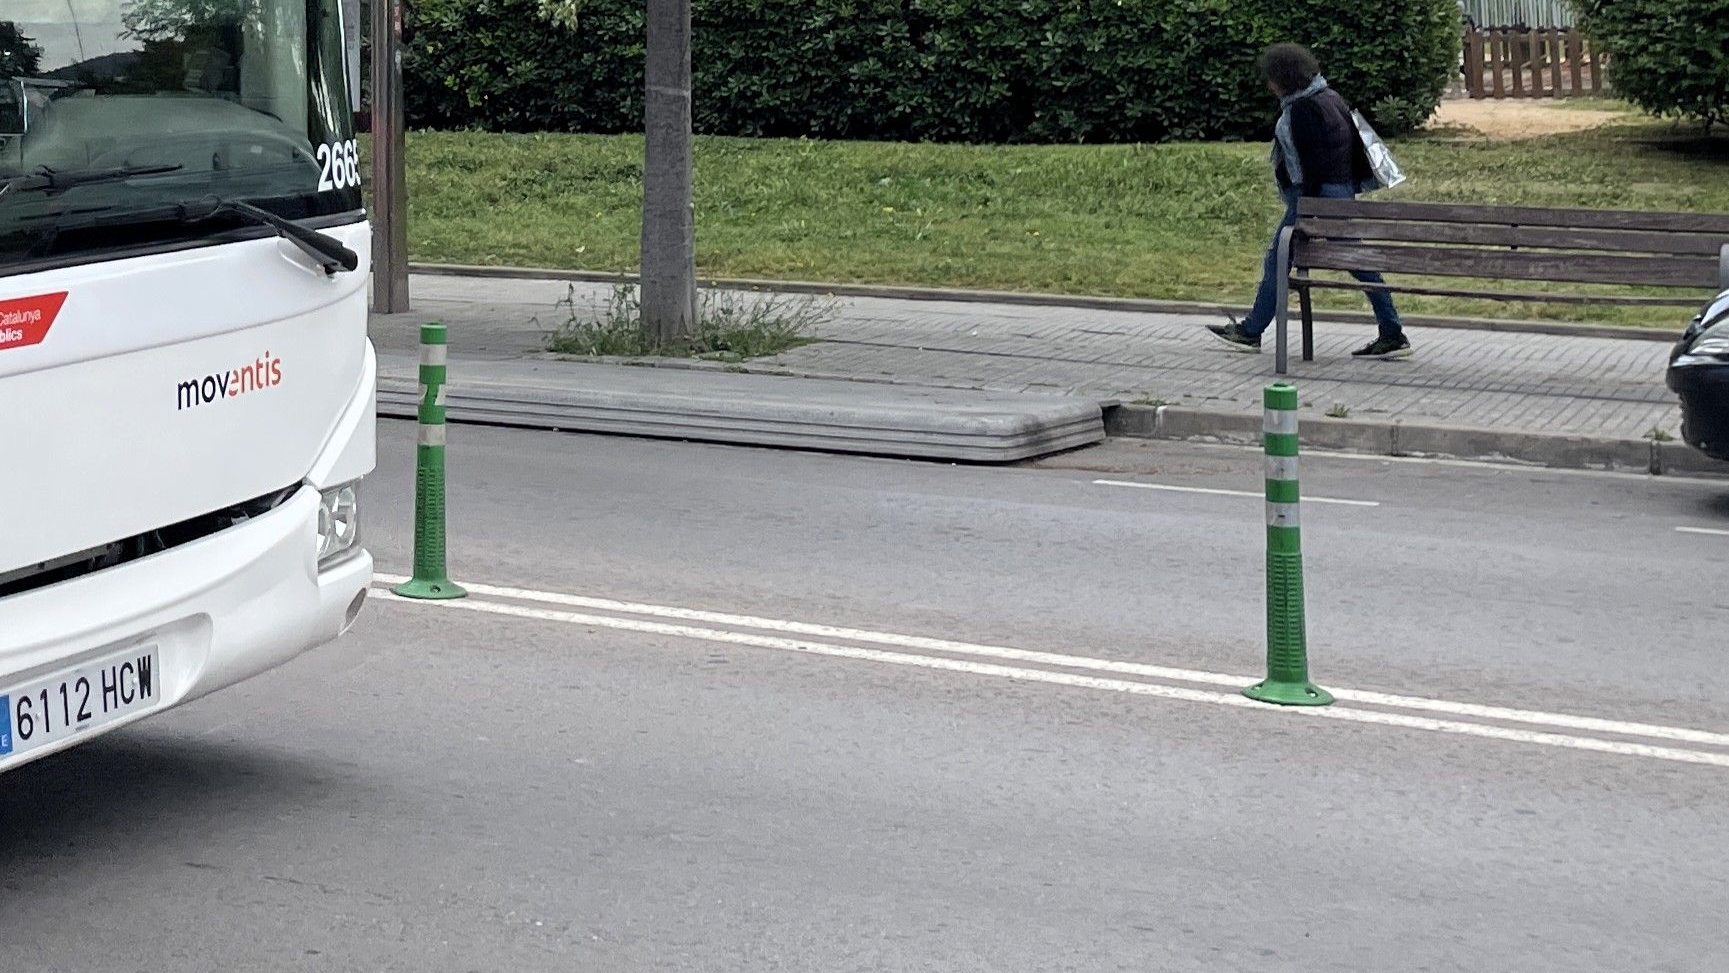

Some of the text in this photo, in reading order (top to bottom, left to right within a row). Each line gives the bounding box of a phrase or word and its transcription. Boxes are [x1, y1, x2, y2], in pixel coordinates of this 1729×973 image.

[177, 350, 281, 410] moventis
[16, 654, 151, 740] 6112 HCW
[1, 734, 9, 747] E
